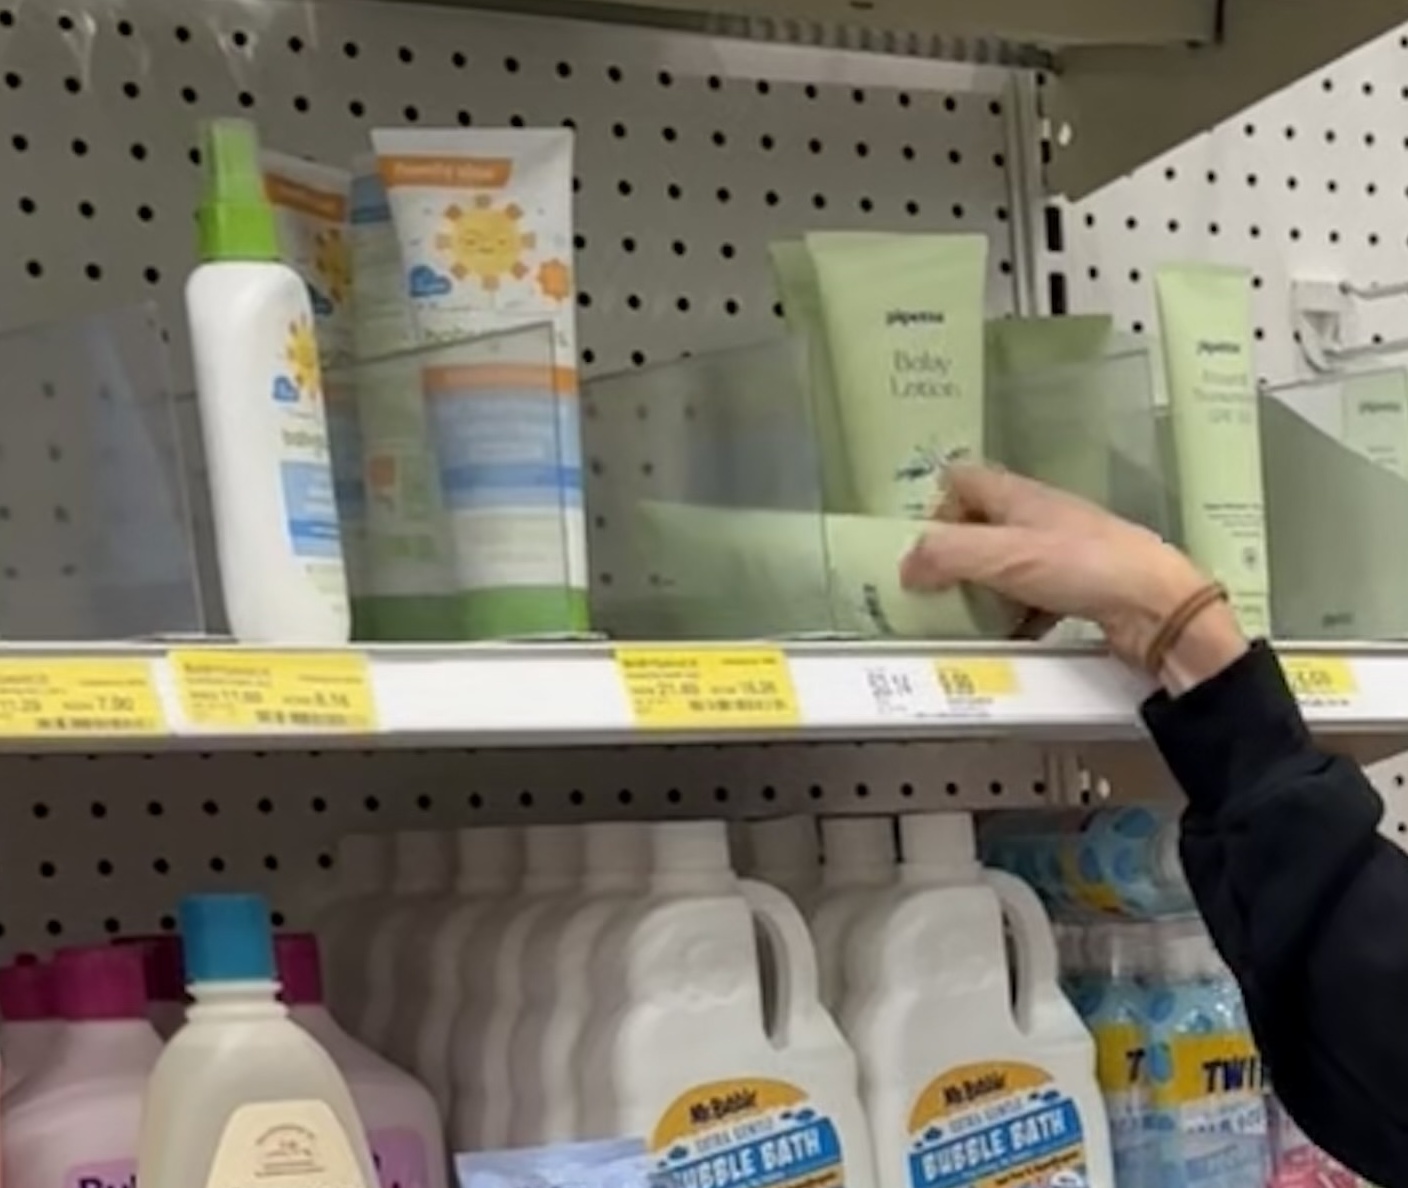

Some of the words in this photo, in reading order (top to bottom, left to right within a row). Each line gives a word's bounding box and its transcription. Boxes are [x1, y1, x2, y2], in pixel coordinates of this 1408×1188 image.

[893, 349, 952, 376] Baby
[889, 375, 961, 400] Lotion
[1203, 1052, 1268, 1094] TWI
[760, 1126, 822, 1171] BATH
[920, 1128, 1005, 1182] BUBBLE
[1009, 1108, 1067, 1151] BATH
